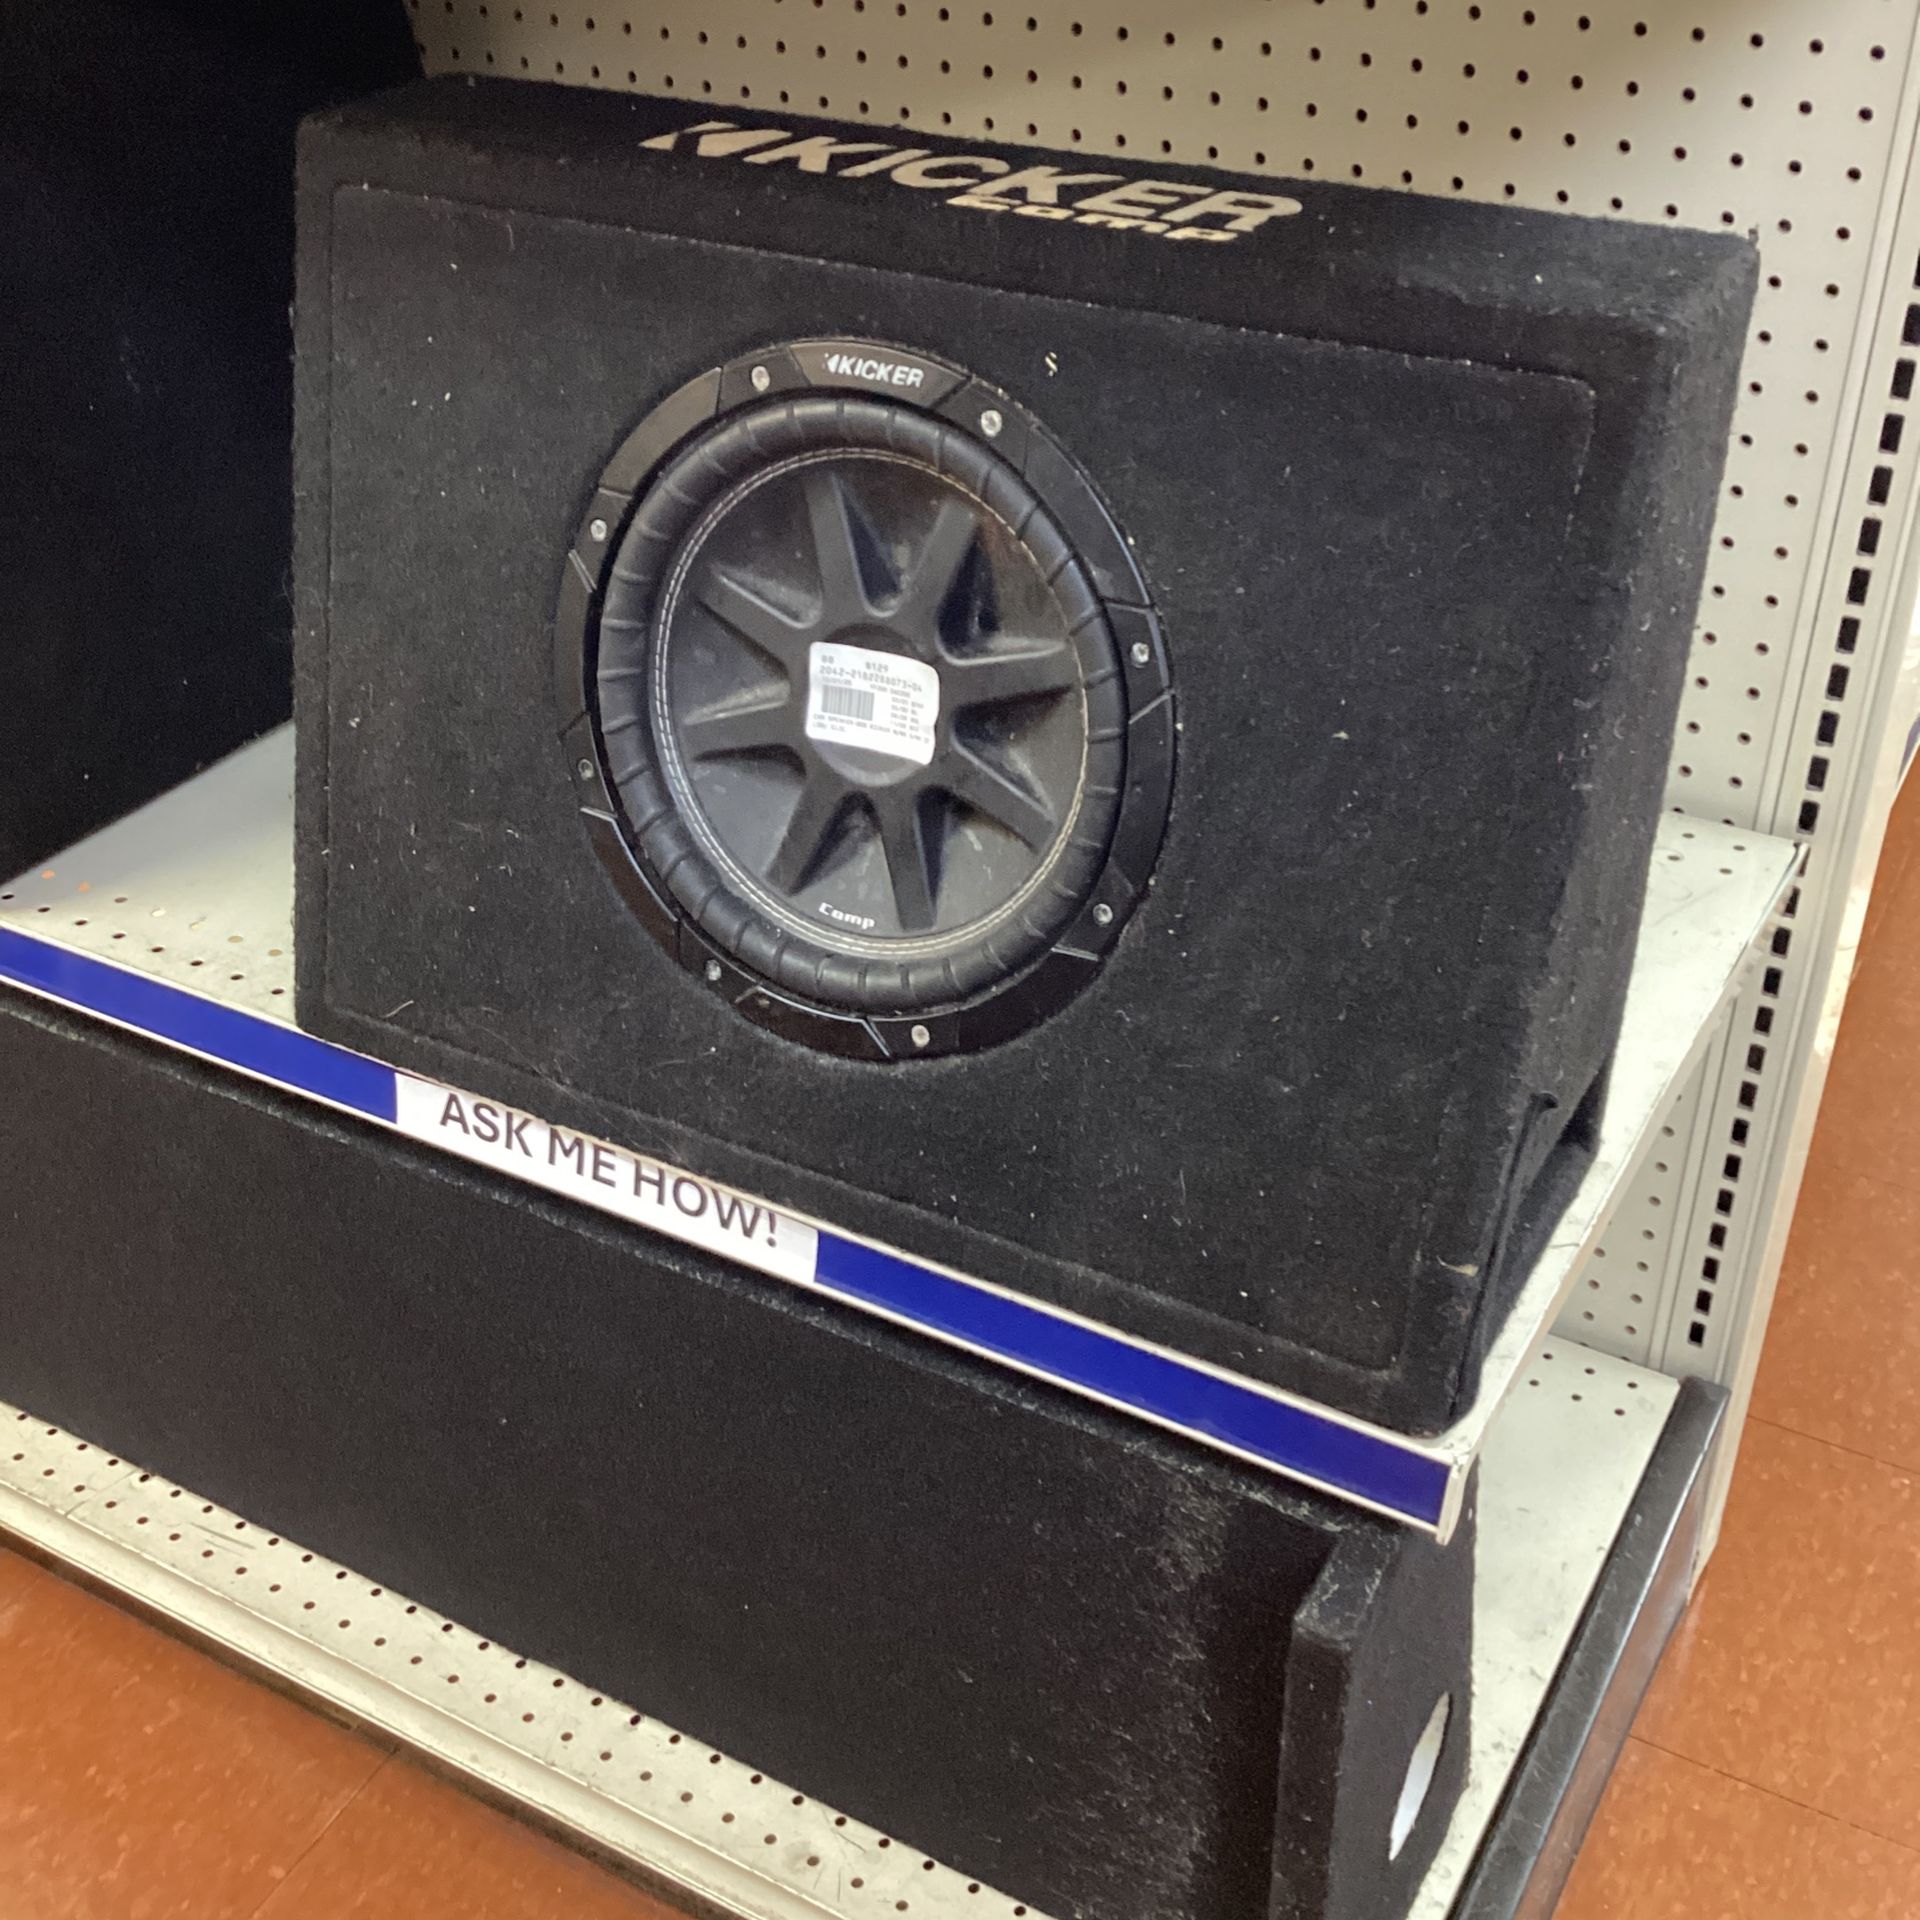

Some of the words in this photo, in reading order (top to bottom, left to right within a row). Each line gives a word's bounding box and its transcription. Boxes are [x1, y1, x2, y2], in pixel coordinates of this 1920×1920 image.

[743, 136, 1303, 232] KICKER
[838, 355, 924, 388] KICKER
[819, 902, 875, 930] Comp
[439, 1093, 534, 1158] ASK
[547, 1126, 617, 1188] ME
[633, 1159, 779, 1248] HOW!
